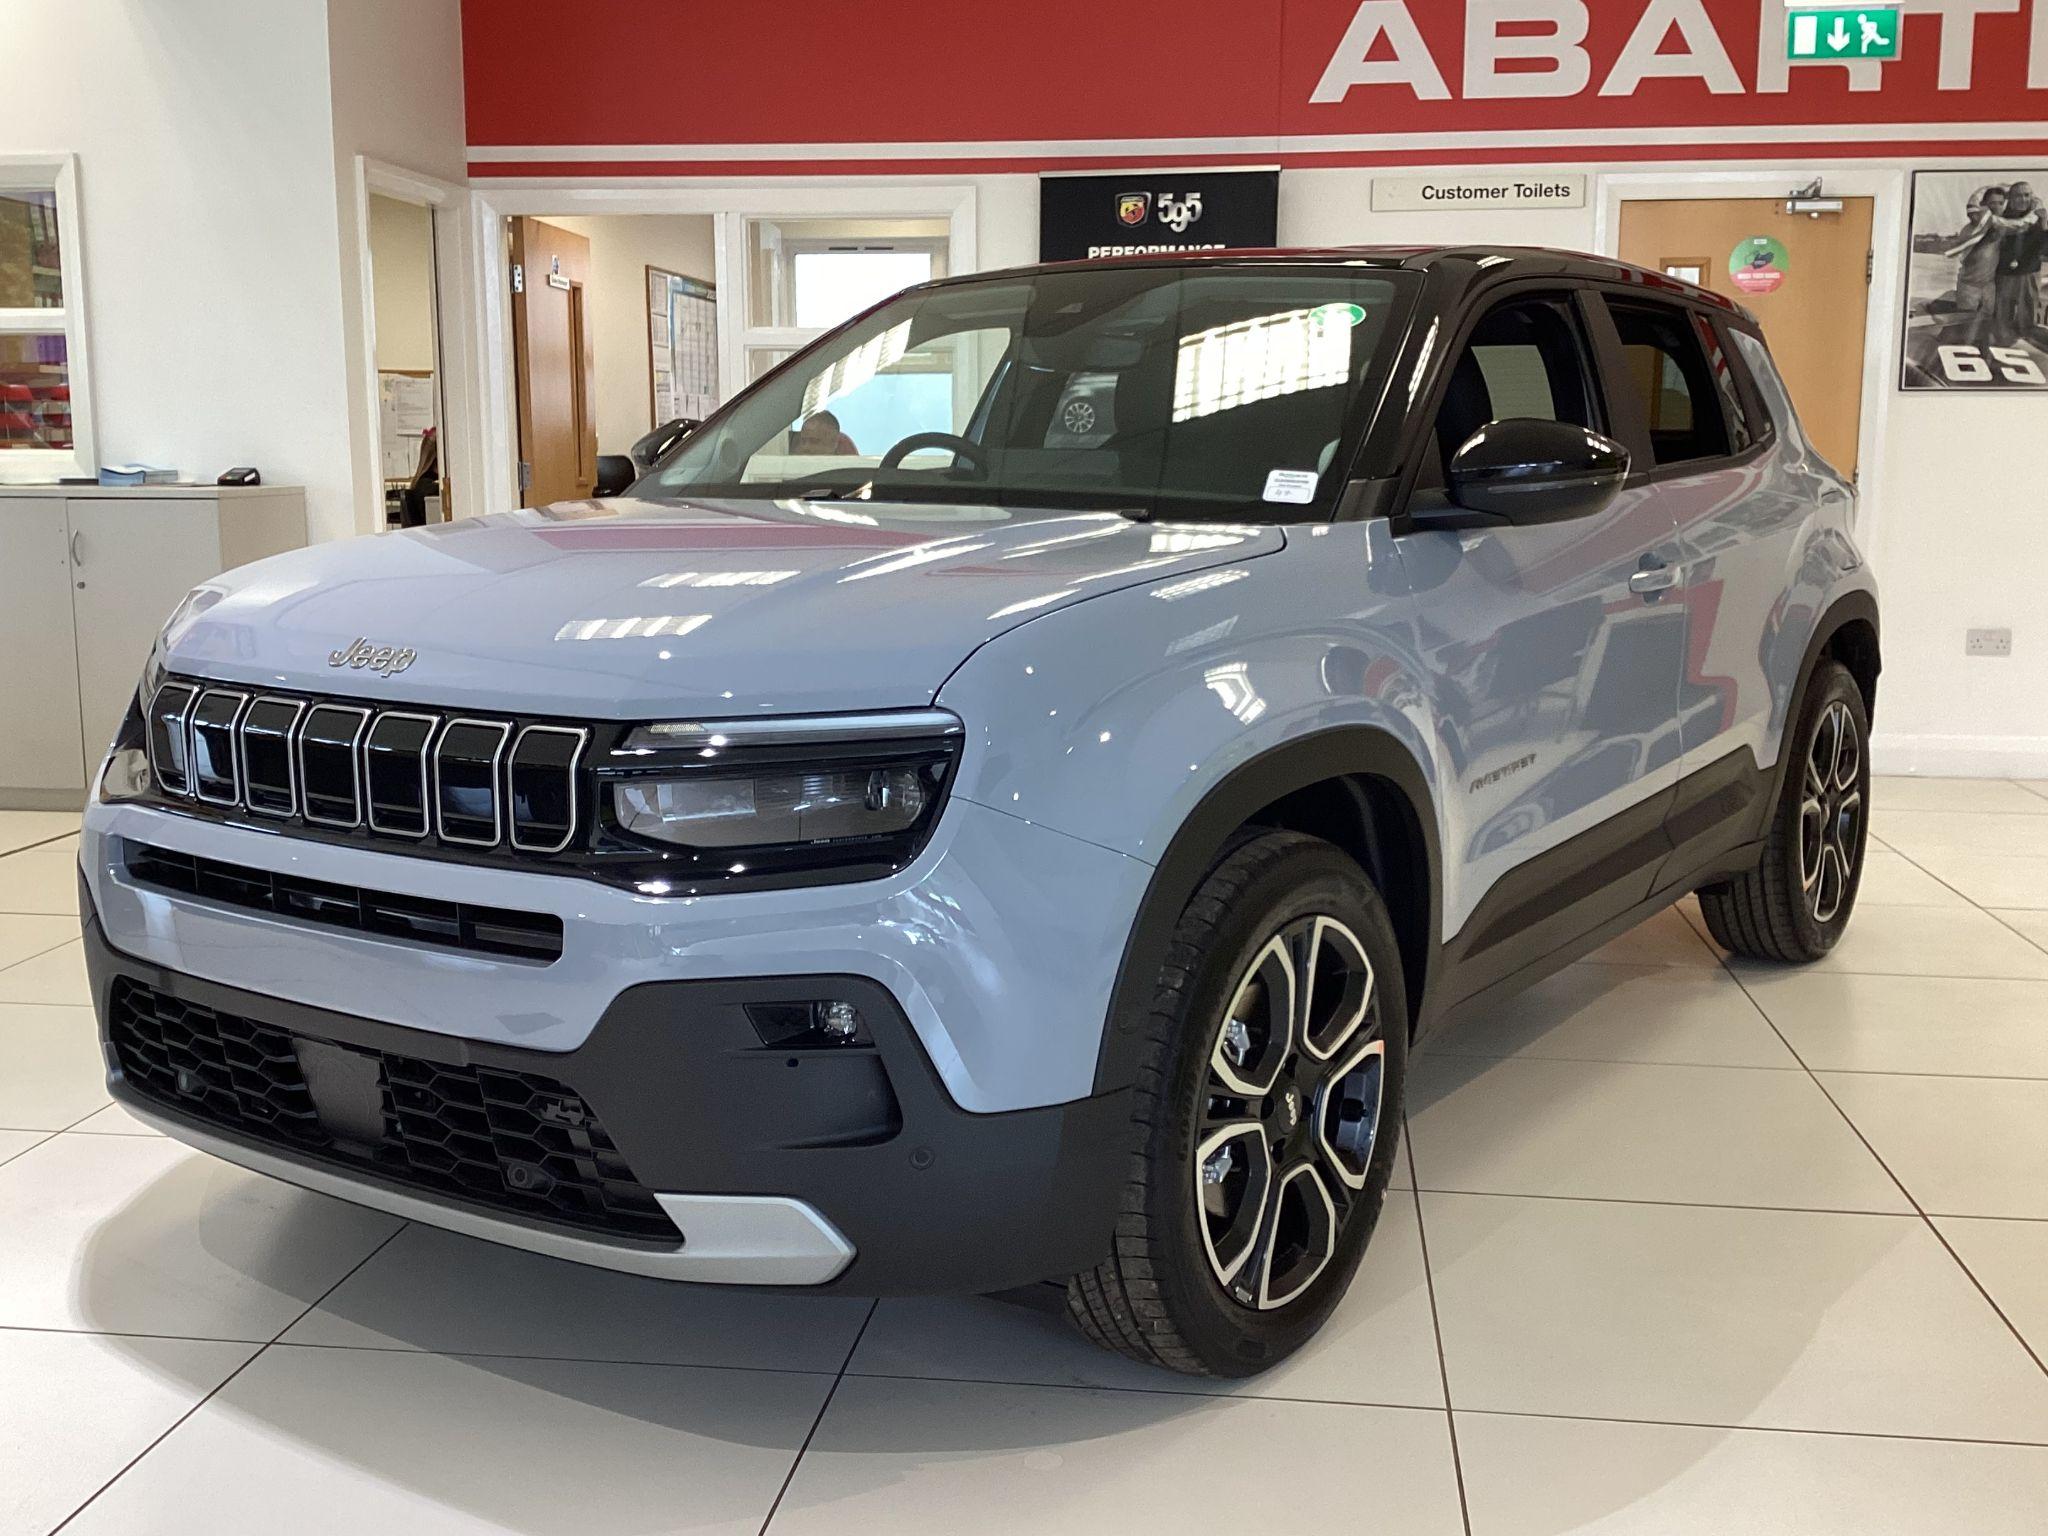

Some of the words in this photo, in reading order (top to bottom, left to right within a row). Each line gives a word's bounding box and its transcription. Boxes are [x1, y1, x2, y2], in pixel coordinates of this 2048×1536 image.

[1308, 0, 2048, 104] ABART
[1421, 184, 1509, 200] Customer
[1513, 183, 1571, 198] Toilets
[1157, 192, 1203, 233] 595
[1937, 344, 2047, 385] 65
[328, 636, 418, 679] Jeep
